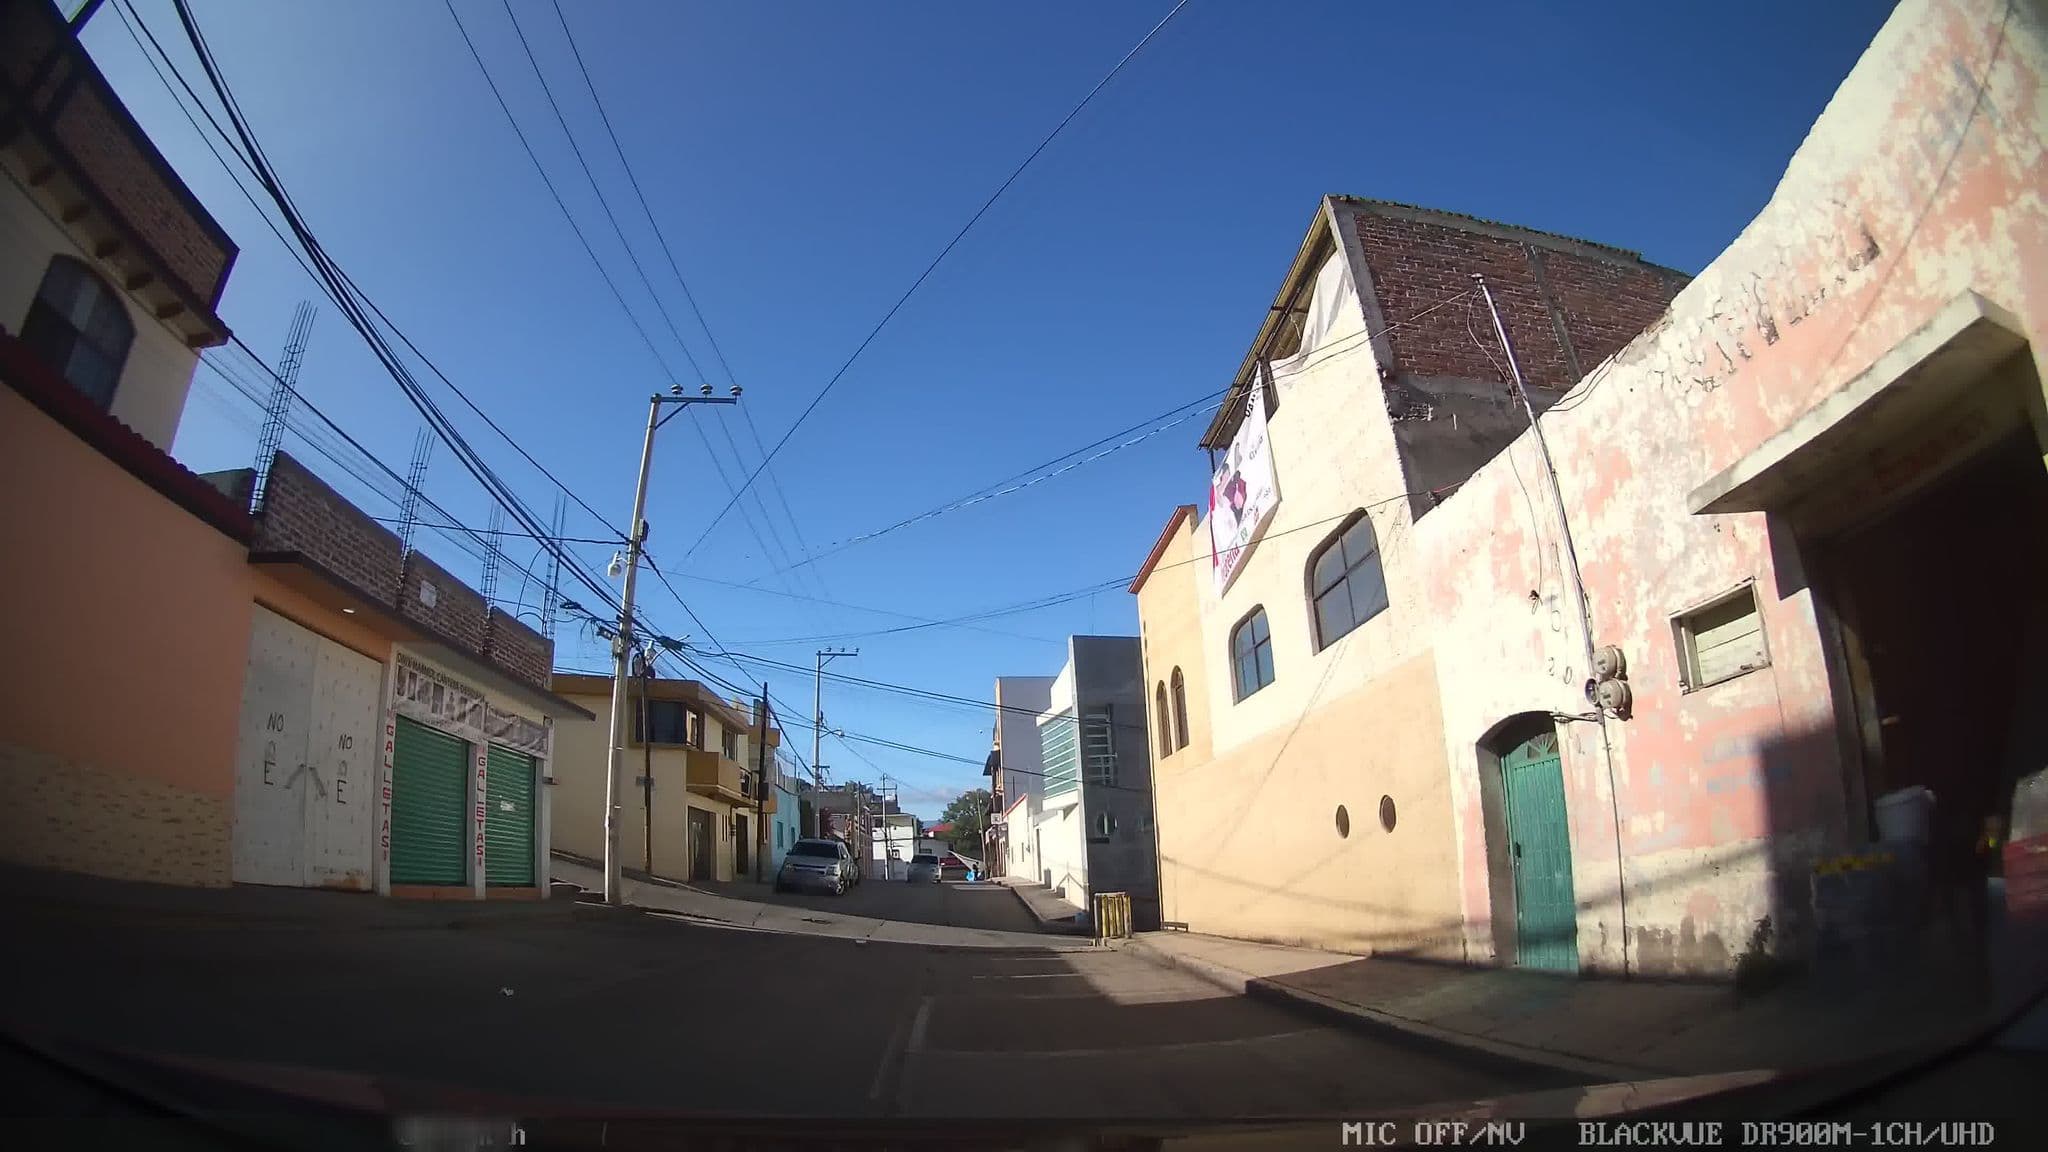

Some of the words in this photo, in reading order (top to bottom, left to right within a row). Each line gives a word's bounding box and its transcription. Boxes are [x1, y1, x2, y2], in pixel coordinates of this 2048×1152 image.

[267, 712, 284, 732] NO
[338, 734, 353, 751] NO
[263, 760, 276, 786] E
[336, 779, 347, 805] E
